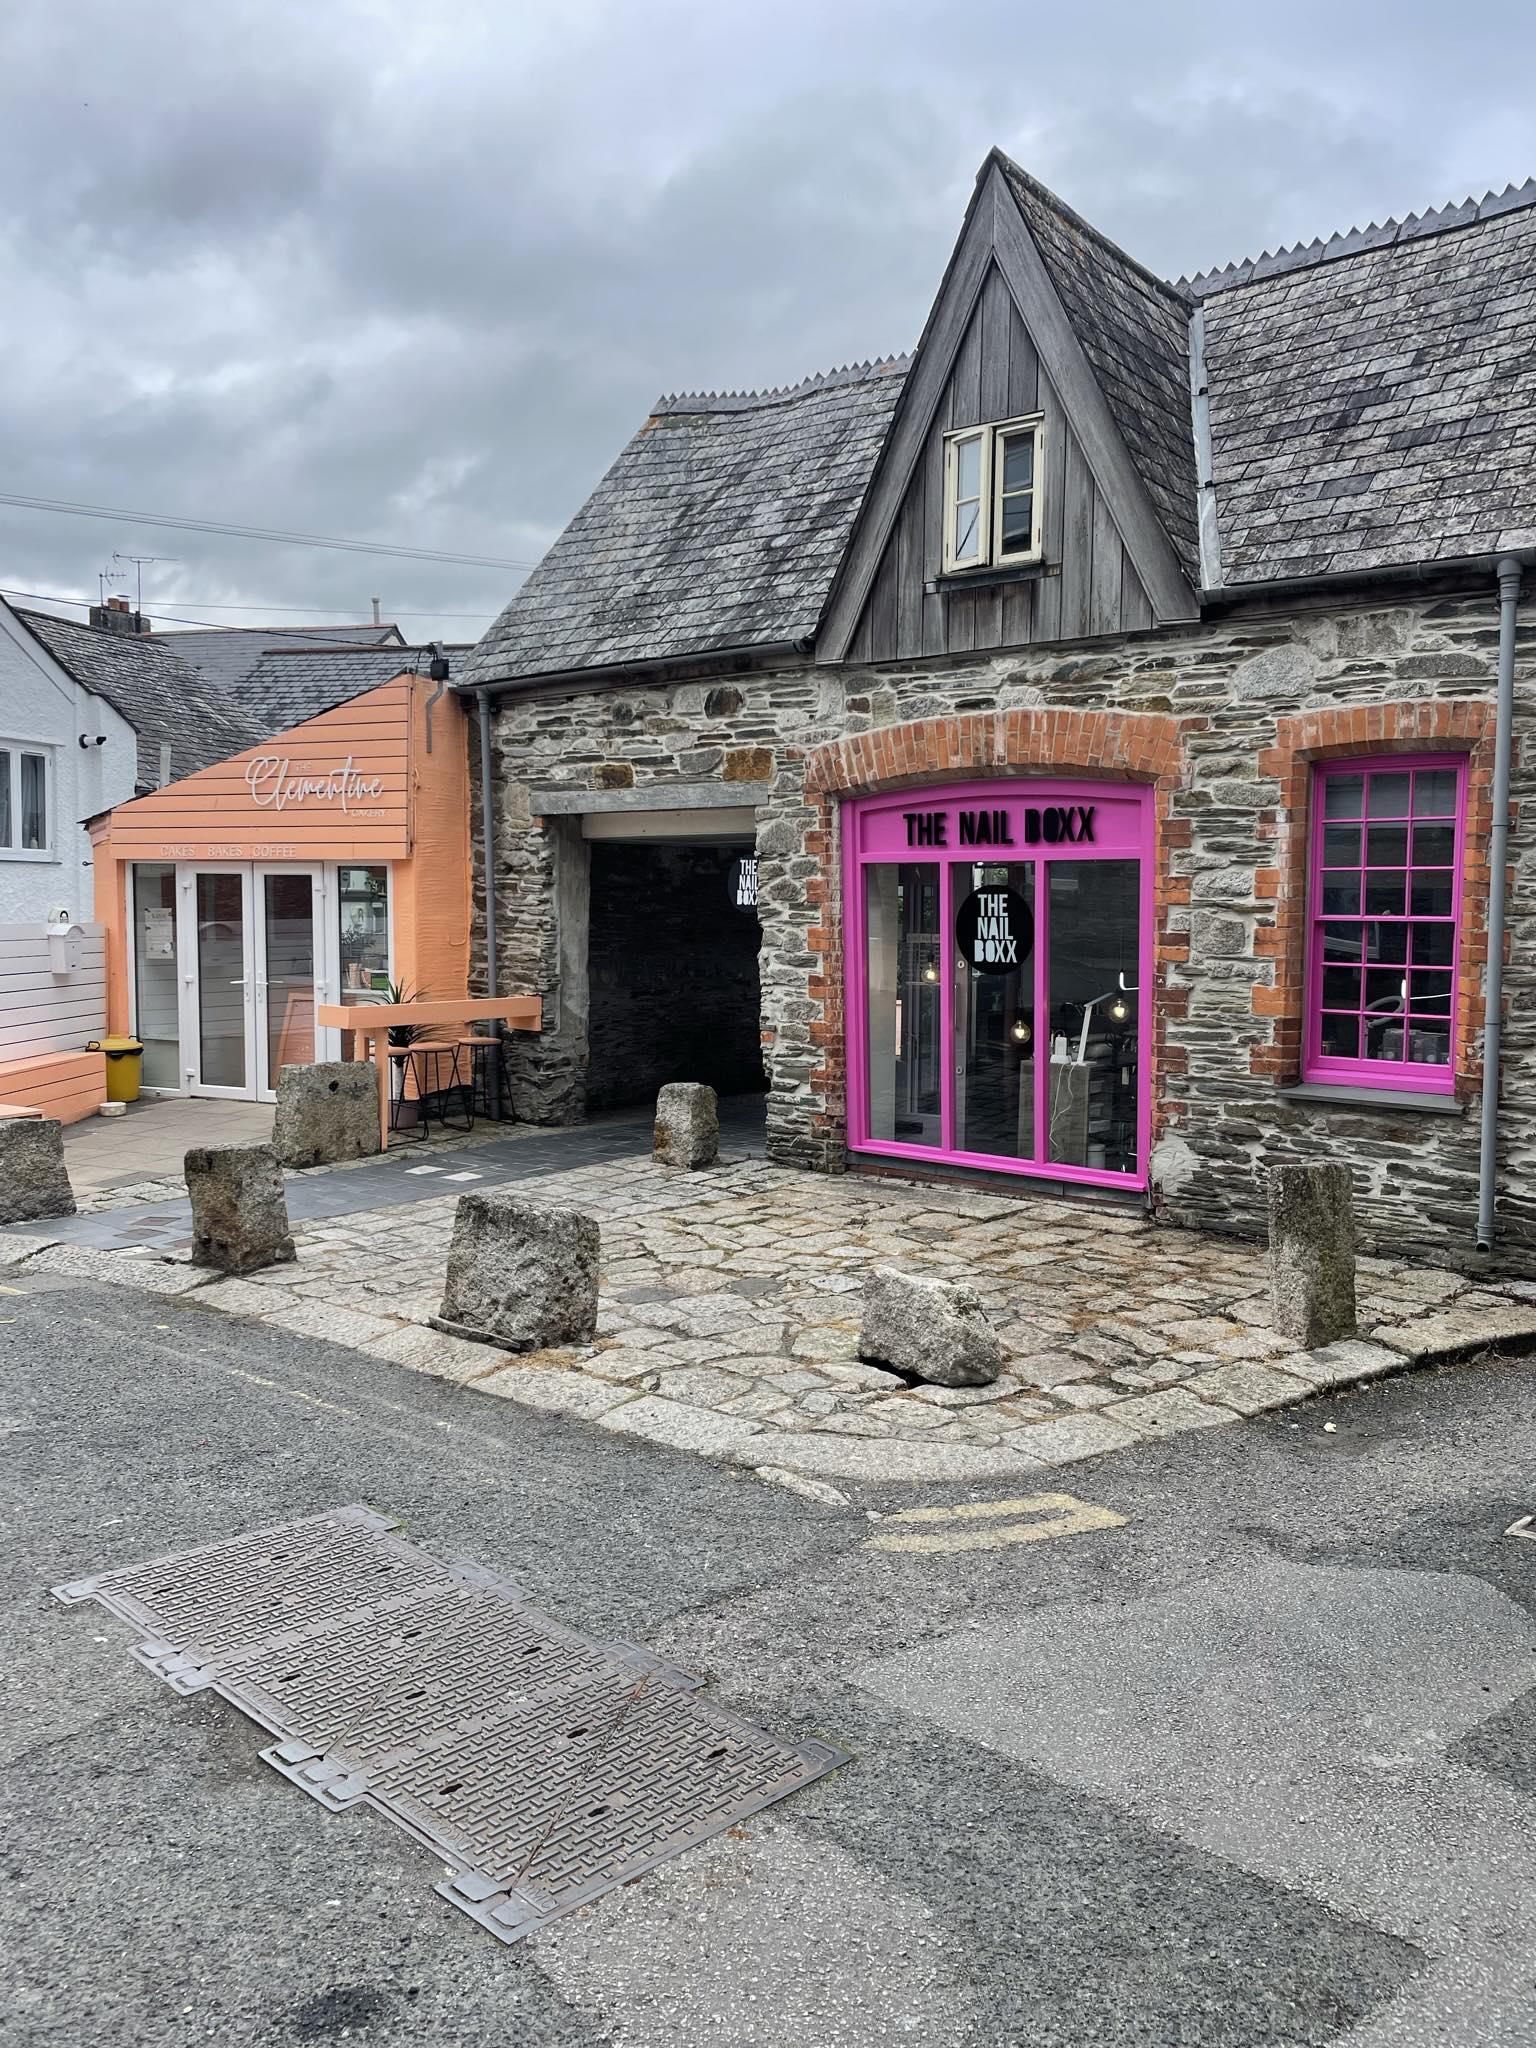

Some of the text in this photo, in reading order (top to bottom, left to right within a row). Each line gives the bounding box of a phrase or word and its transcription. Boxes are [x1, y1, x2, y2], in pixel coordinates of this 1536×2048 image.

[295, 763, 312, 773] THE
[245, 756, 384, 814] Clementine
[903, 806, 1095, 846] THE NAIL BOXX
[160, 846, 297, 857] CAKES BAKES COFFEE
[740, 859, 757, 875] THE
[739, 874, 758, 890] NAIL
[977, 893, 1009, 917] THE
[977, 917, 1014, 940] NAIL
[974, 939, 1018, 963] BOXX
